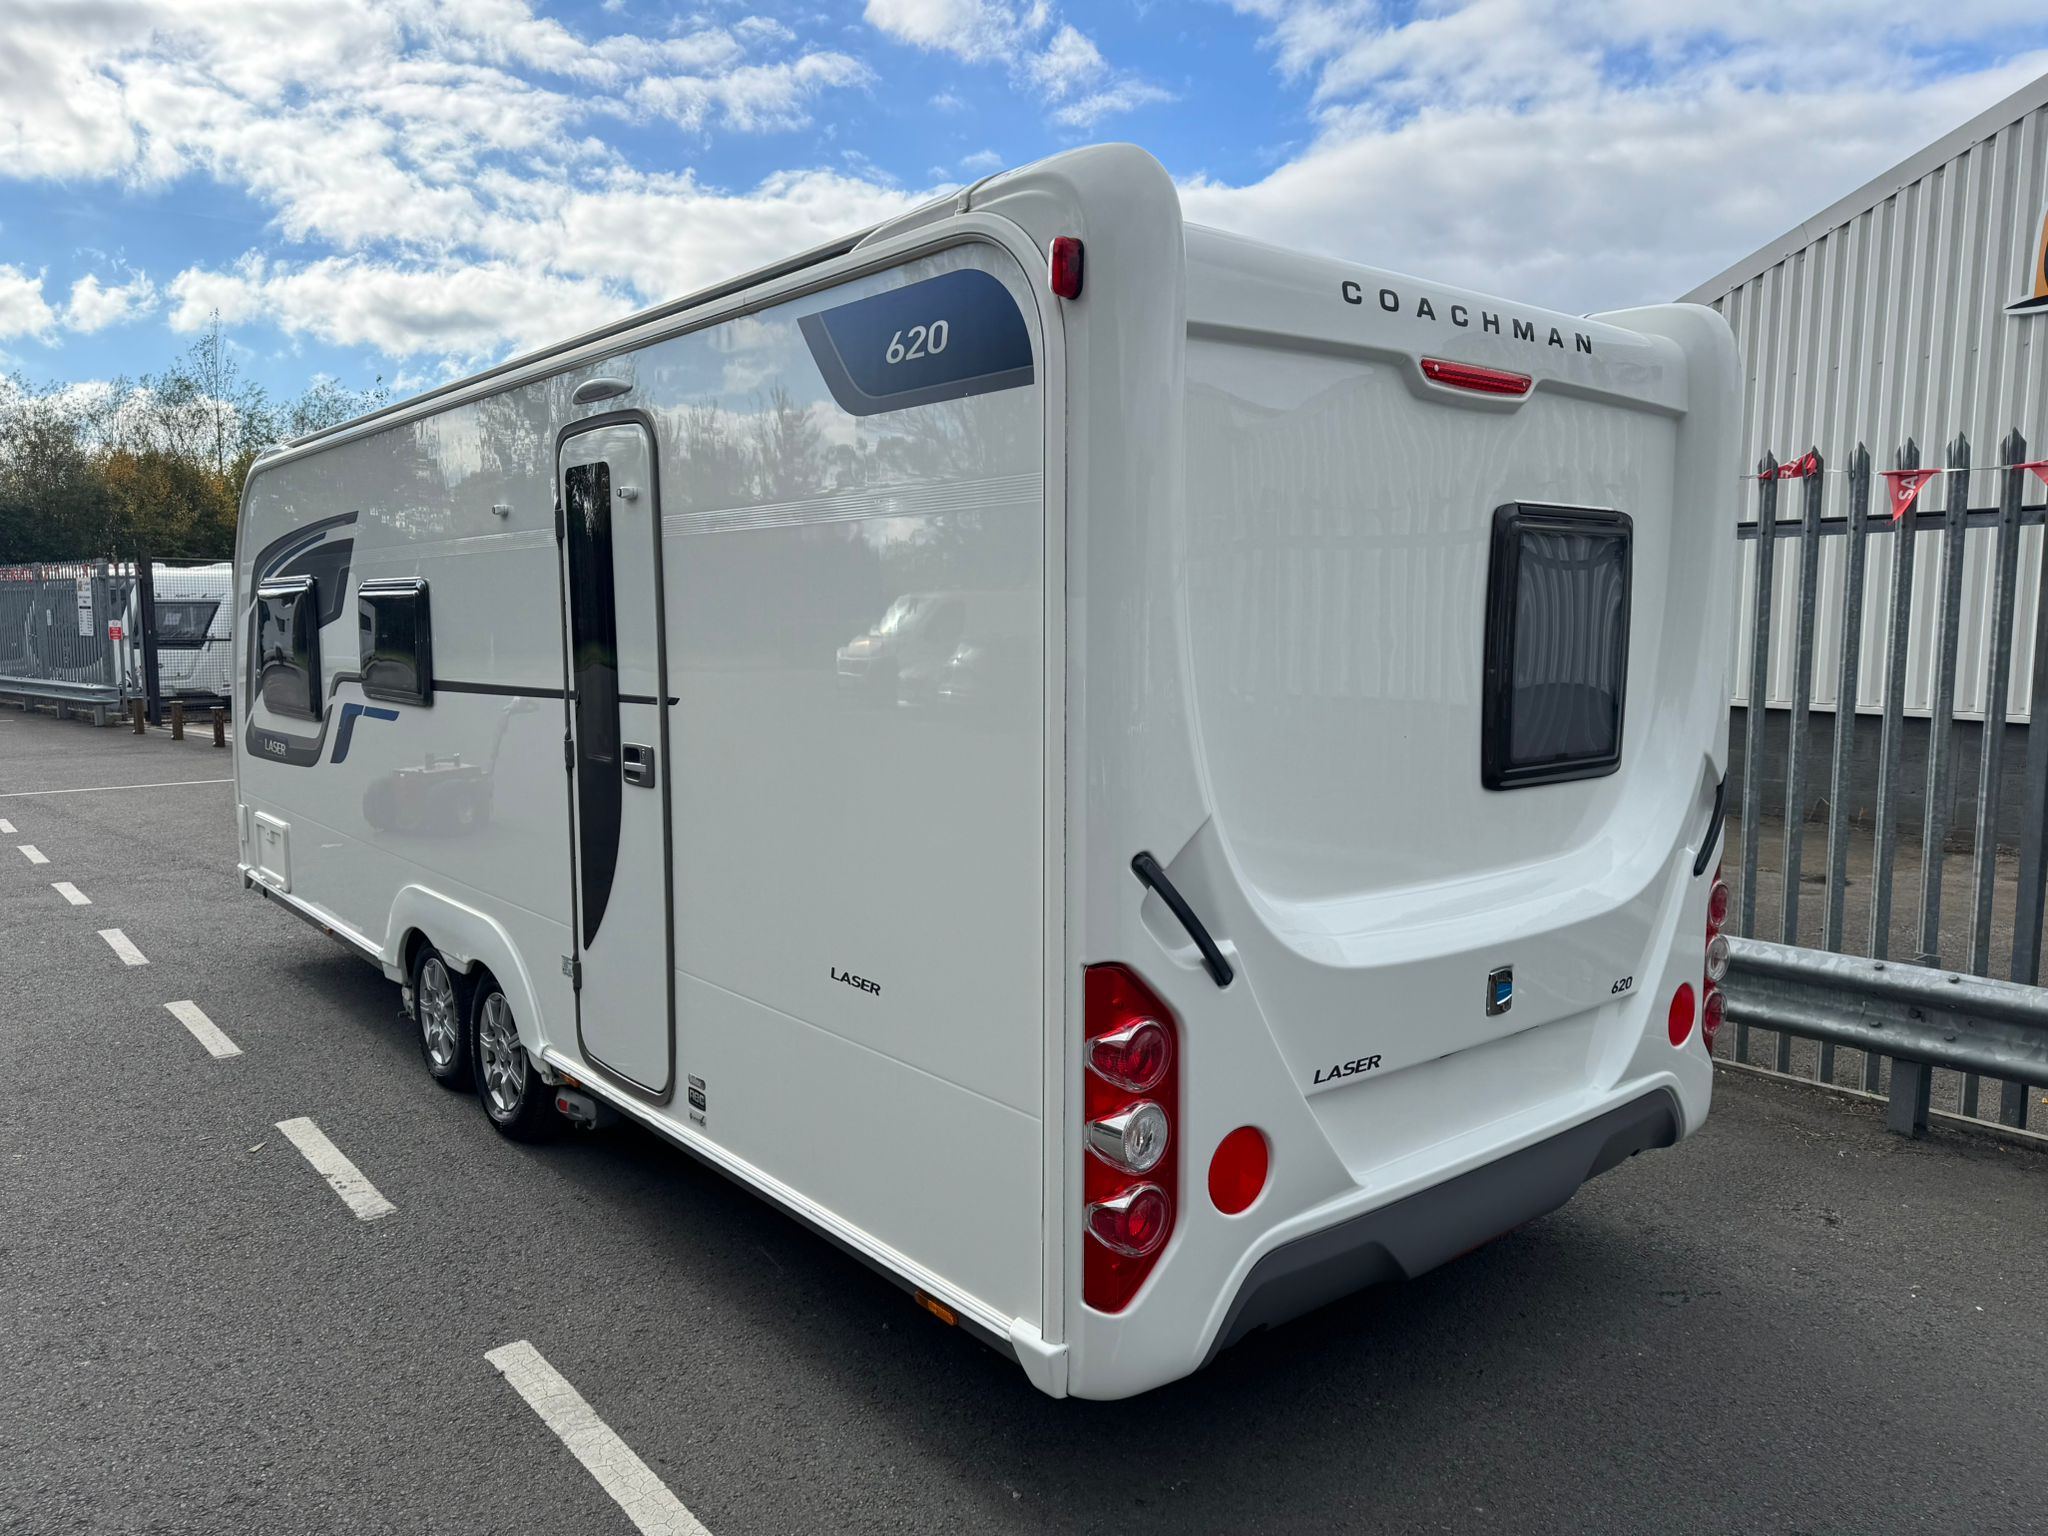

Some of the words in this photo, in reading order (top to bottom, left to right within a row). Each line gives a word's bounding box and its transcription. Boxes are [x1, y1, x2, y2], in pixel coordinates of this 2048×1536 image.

[1342, 281, 1592, 354] COACHMAN
[886, 320, 949, 364] 620
[264, 737, 287, 756] LASER
[831, 966, 881, 996] LASER
[1611, 976, 1633, 994] 620
[1313, 1054, 1382, 1084] LASER
